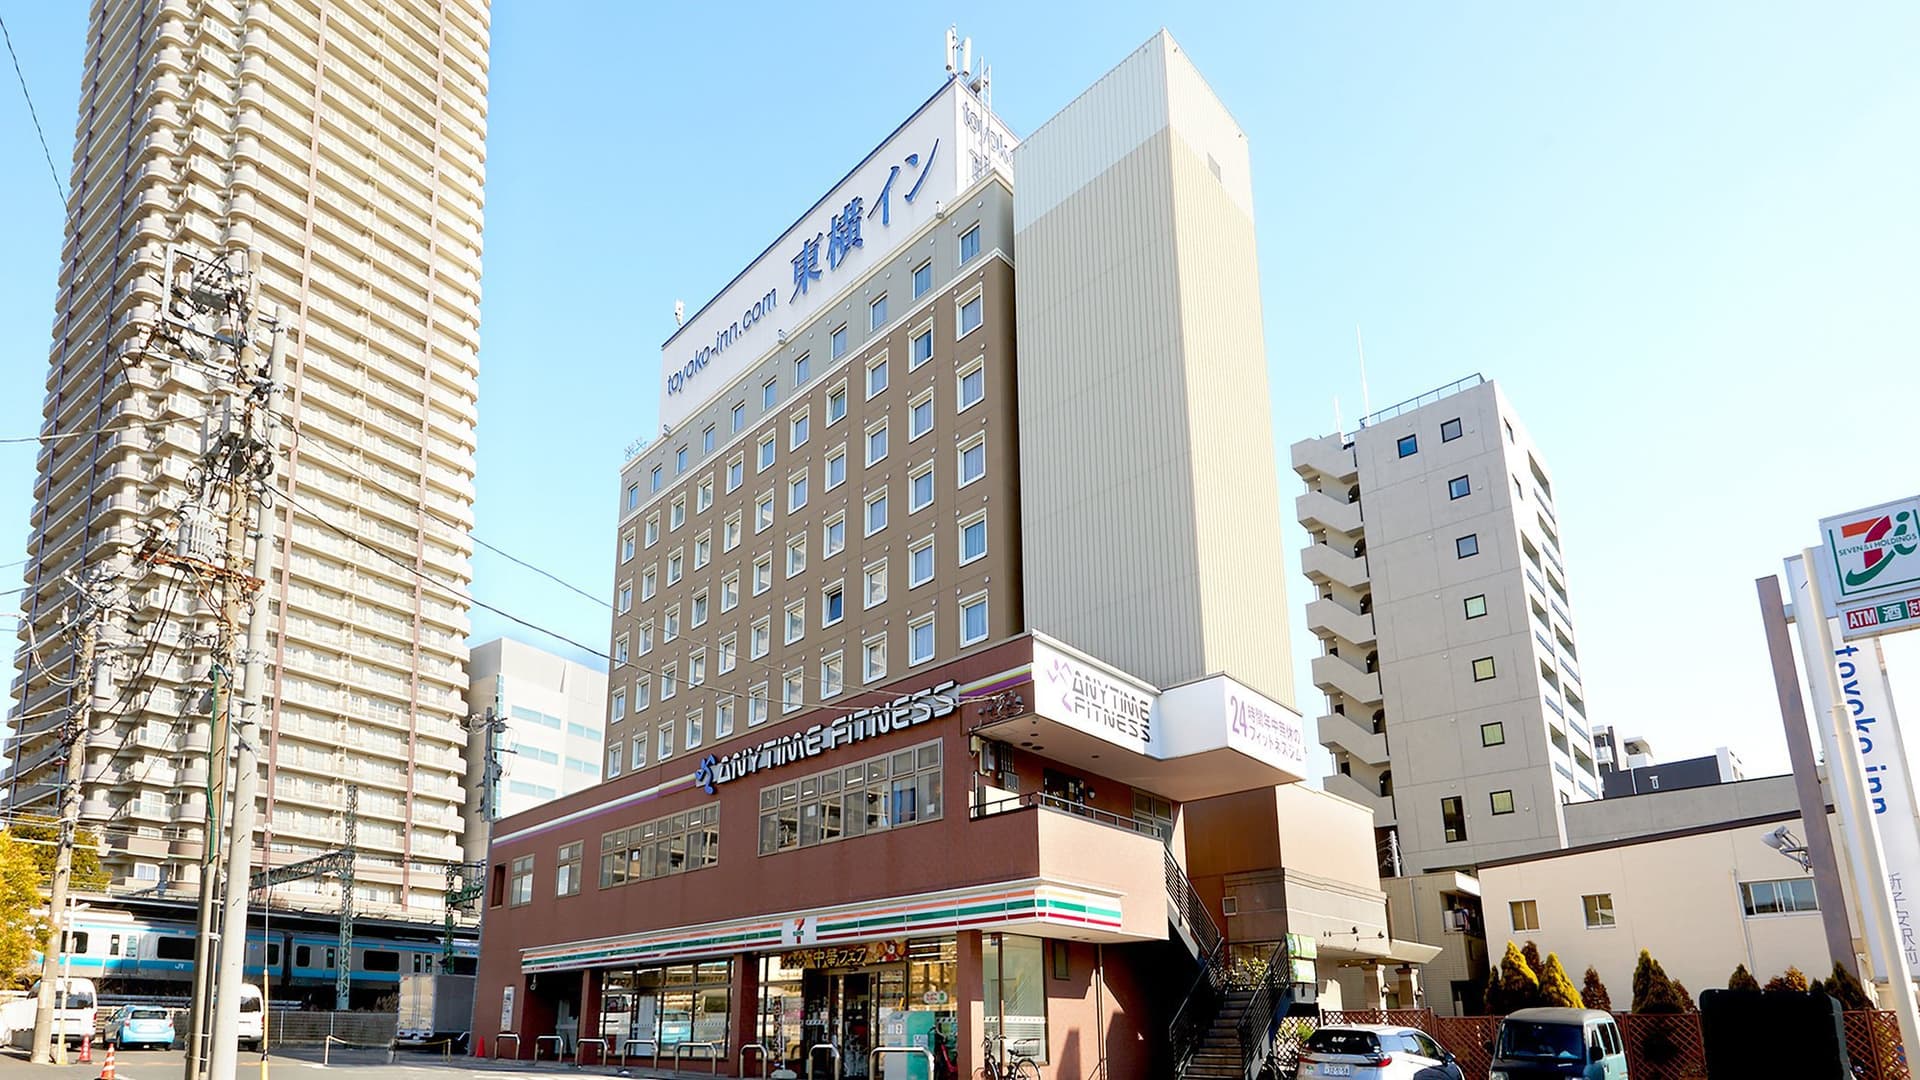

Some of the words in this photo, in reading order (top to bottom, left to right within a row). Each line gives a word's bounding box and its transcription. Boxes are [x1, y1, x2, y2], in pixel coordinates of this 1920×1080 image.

[789, 138, 940, 304] 東横イン
[667, 287, 777, 396] toyoko-inn.com
[1874, 533, 1917, 549] HOLDINGS
[1850, 609, 1877, 628] ATM
[1882, 604, 1903, 621] 酒
[1909, 600, 1920, 617] た
[1072, 670, 1150, 724] ANYTIME
[1074, 696, 1151, 743] FITNESS
[717, 724, 822, 785] ANYTIME
[830, 680, 958, 750] FITNESS
[1865, 765, 1887, 815] inn
